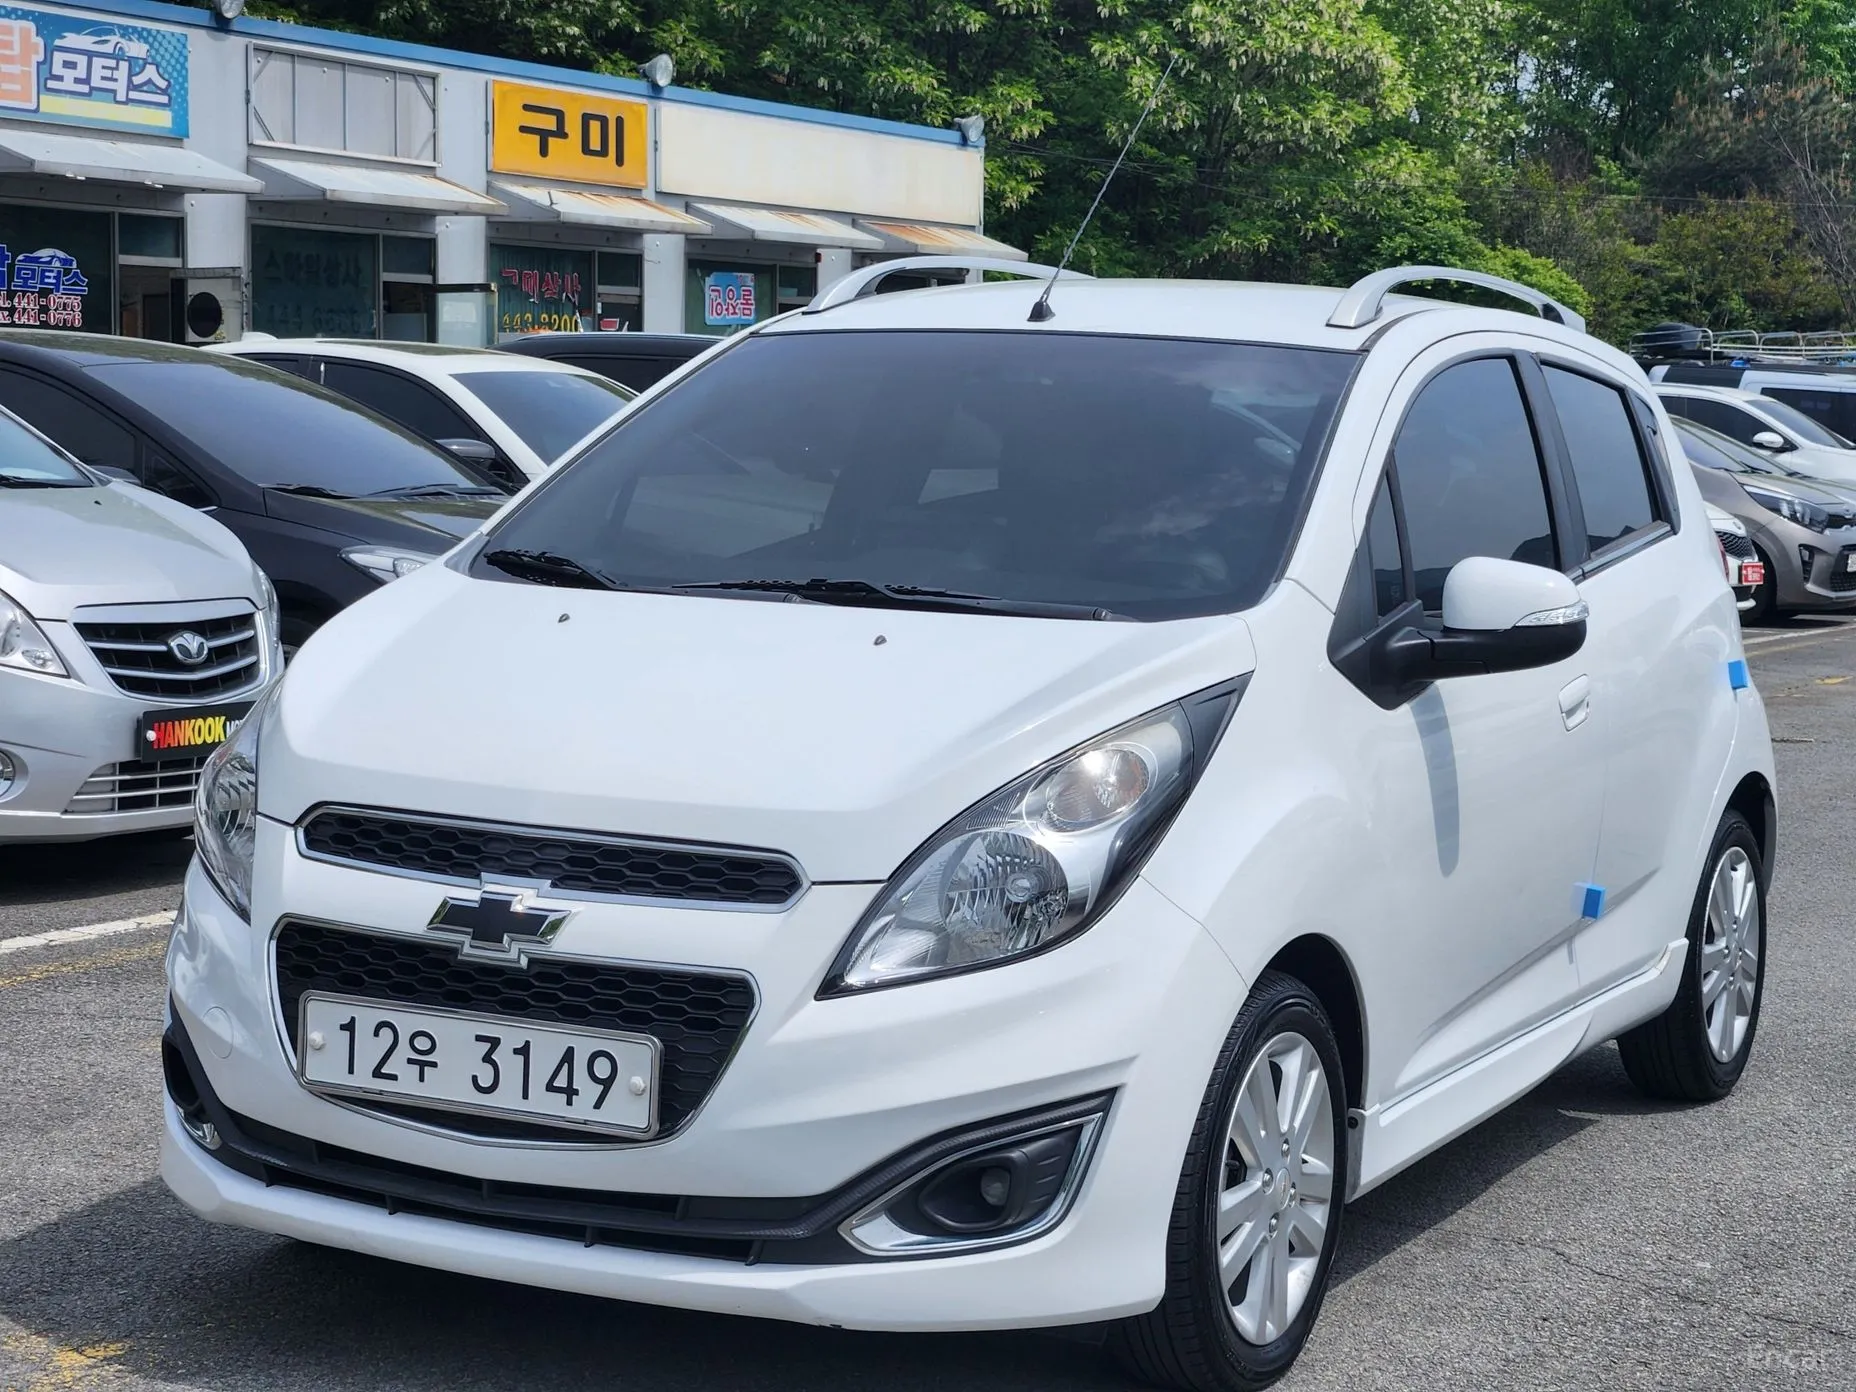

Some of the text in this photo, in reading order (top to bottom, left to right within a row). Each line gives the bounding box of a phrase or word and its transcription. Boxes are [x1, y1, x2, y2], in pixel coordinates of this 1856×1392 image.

[45, 51, 170, 104] 모터스
[518, 103, 624, 168] 구미
[11, 265, 88, 294] 모터스
[13, 292, 82, 311] 441-0775
[13, 308, 82, 327] 441-0776
[153, 716, 226, 749] HANKOOK
[339, 1015, 619, 1110] 12우 3149
